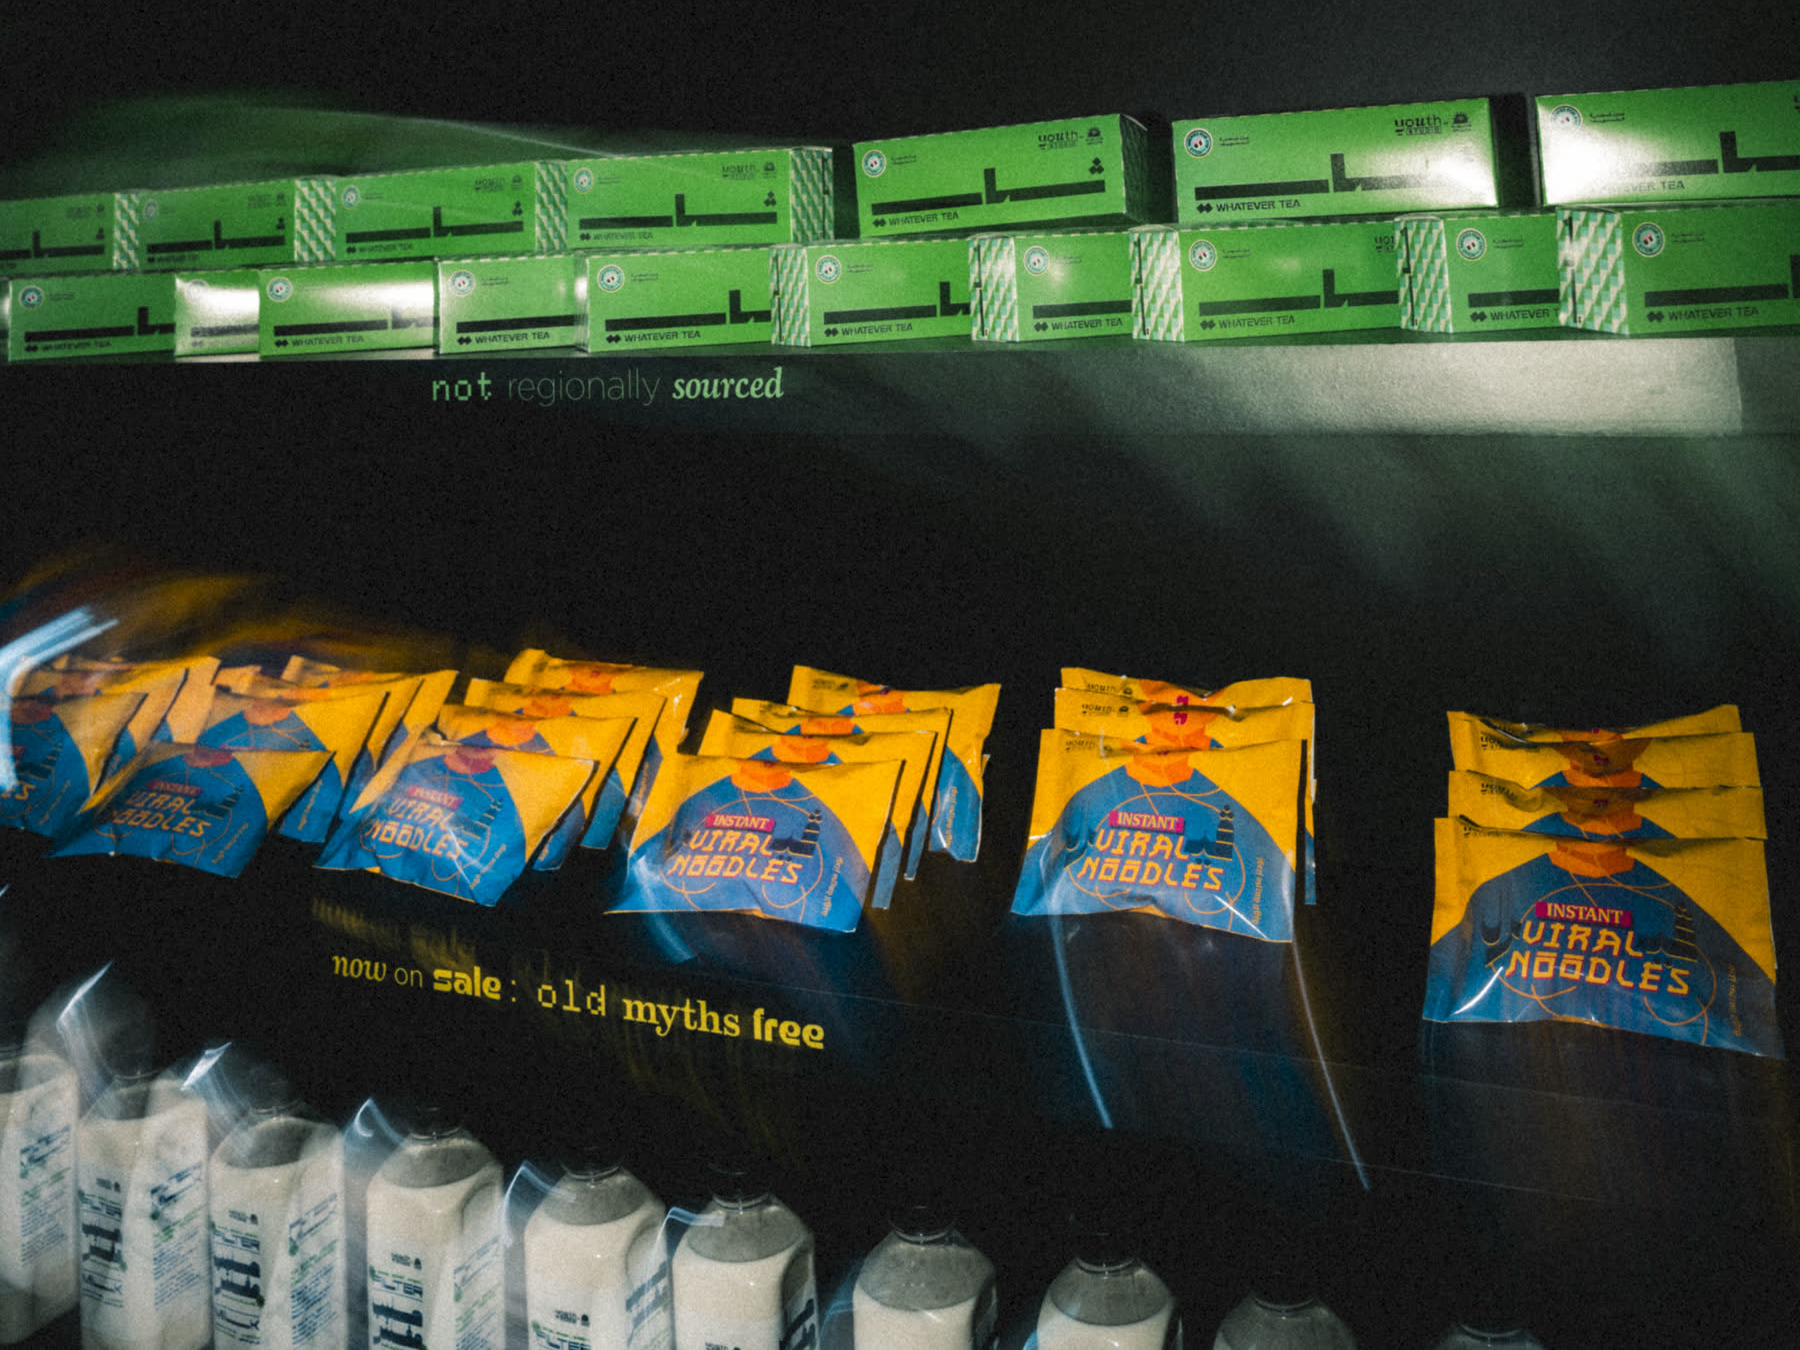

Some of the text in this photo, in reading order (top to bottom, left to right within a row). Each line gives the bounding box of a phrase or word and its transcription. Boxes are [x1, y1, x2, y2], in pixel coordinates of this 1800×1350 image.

[1660, 180, 1685, 191] TEA
[1216, 200, 1300, 212] WHATEVER TEA
[889, 211, 959, 226] WHATEVER TEA
[1490, 309, 1550, 321] WHATEVER
[1667, 307, 1759, 321] WHATEVER TEA
[1051, 318, 1122, 331] WHATEVER TEA
[1219, 315, 1295, 329] WHATEVER TEA
[624, 331, 700, 342] WHATEVER TEA
[841, 323, 913, 336] WHATEVER TEA
[292, 336, 364, 347] WHATEVER TEA
[475, 332, 550, 345] WHATEVER TEA
[432, 367, 784, 406] not regionally sourced
[713, 815, 770, 830] INSTANT
[1117, 812, 1179, 830] INSTANT
[688, 829, 773, 857] VIRAL
[1095, 827, 1189, 860] VIRAL
[1546, 902, 1624, 925] INSTANT
[1522, 920, 1644, 958] VIRAL
[333, 956, 387, 982] now
[394, 964, 423, 988] on
[433, 966, 501, 1000] sale
[537, 980, 606, 1016] old
[622, 997, 740, 1037] myths
[753, 1008, 824, 1050] free
